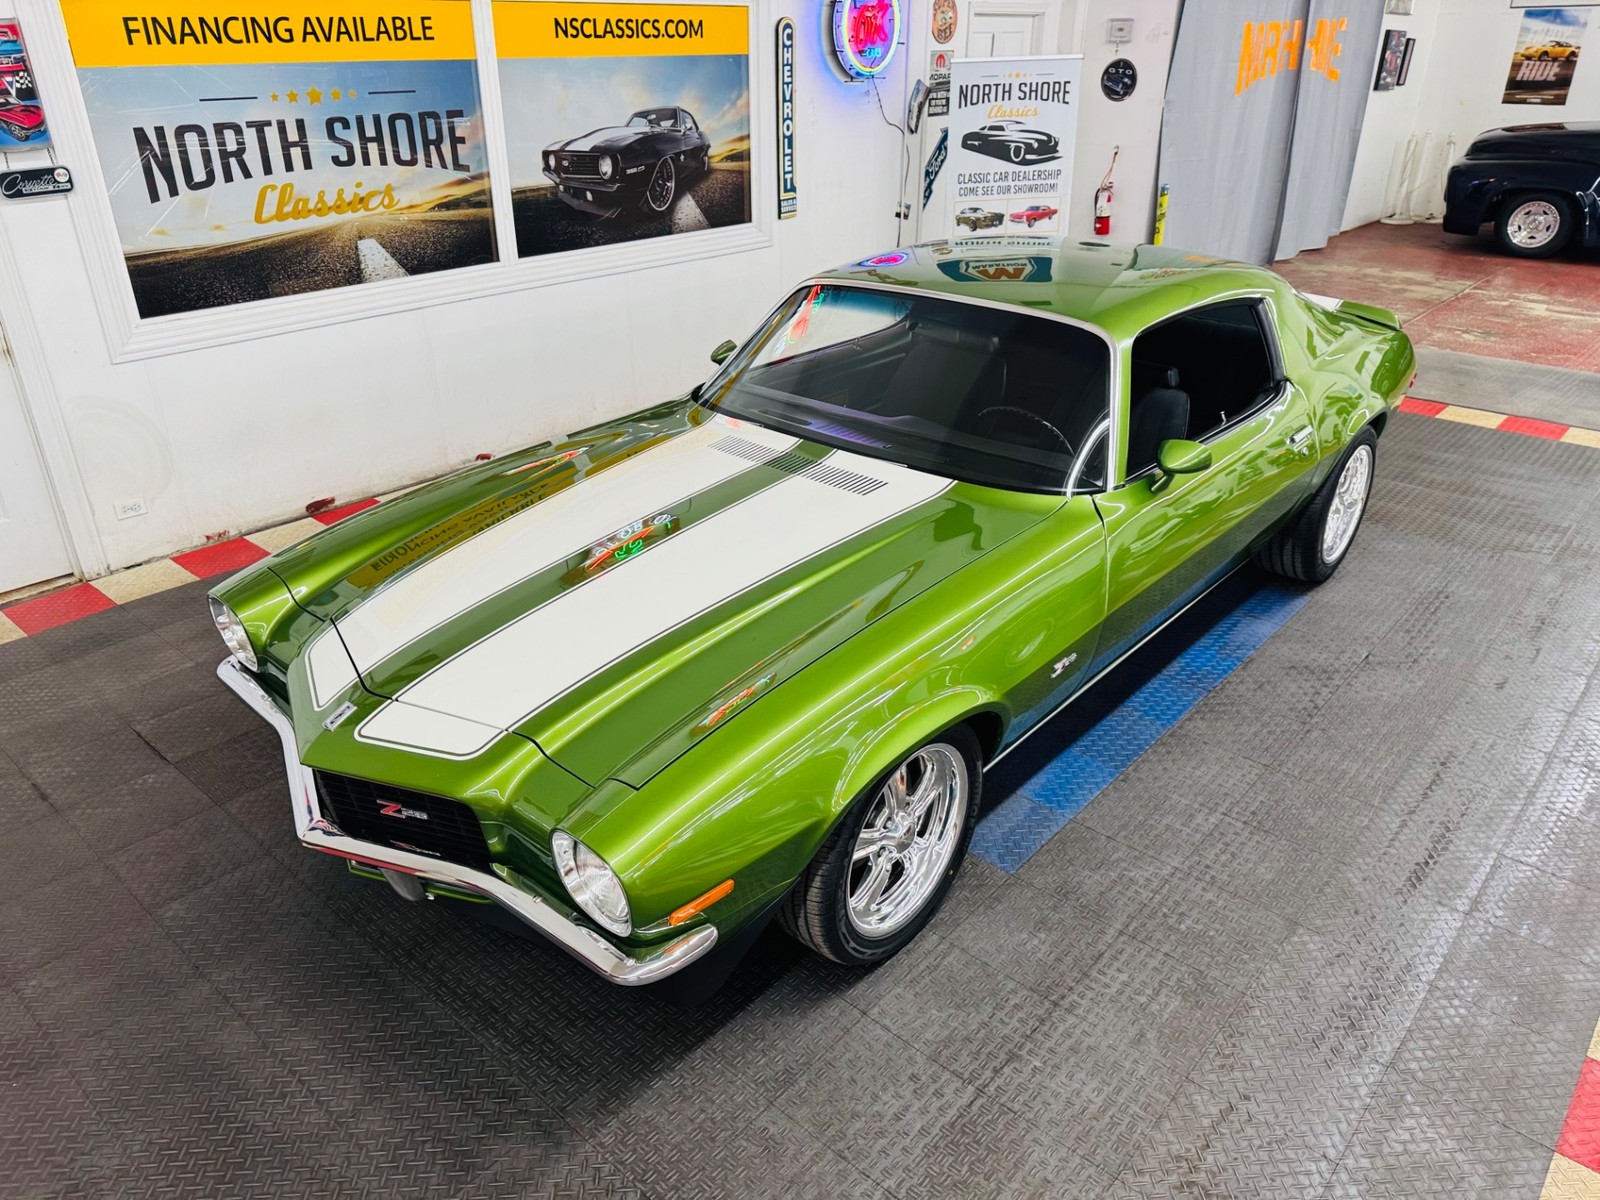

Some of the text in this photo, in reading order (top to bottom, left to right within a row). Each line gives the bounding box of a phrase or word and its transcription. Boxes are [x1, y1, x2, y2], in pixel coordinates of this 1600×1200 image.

[122, 15, 435, 46] FINANCING AVAILABLE
[554, 17, 704, 40] NSCLASSICS.COM
[1108, 66, 1134, 75] GTO
[1515, 60, 1561, 82] RIDE
[958, 82, 1013, 110] NORTH
[1018, 80, 1071, 105] SHORE
[783, 28, 793, 189] CHEVROLET
[987, 103, 1039, 119] Classics
[133, 108, 471, 204] NORTH SHORE
[2, 173, 58, 196] Corvette
[957, 168, 1062, 185] CLASSIC CAR DEALERSHIP
[958, 182, 1059, 197] COME SEE OUR SHOWROOM!
[253, 180, 401, 225] Classics
